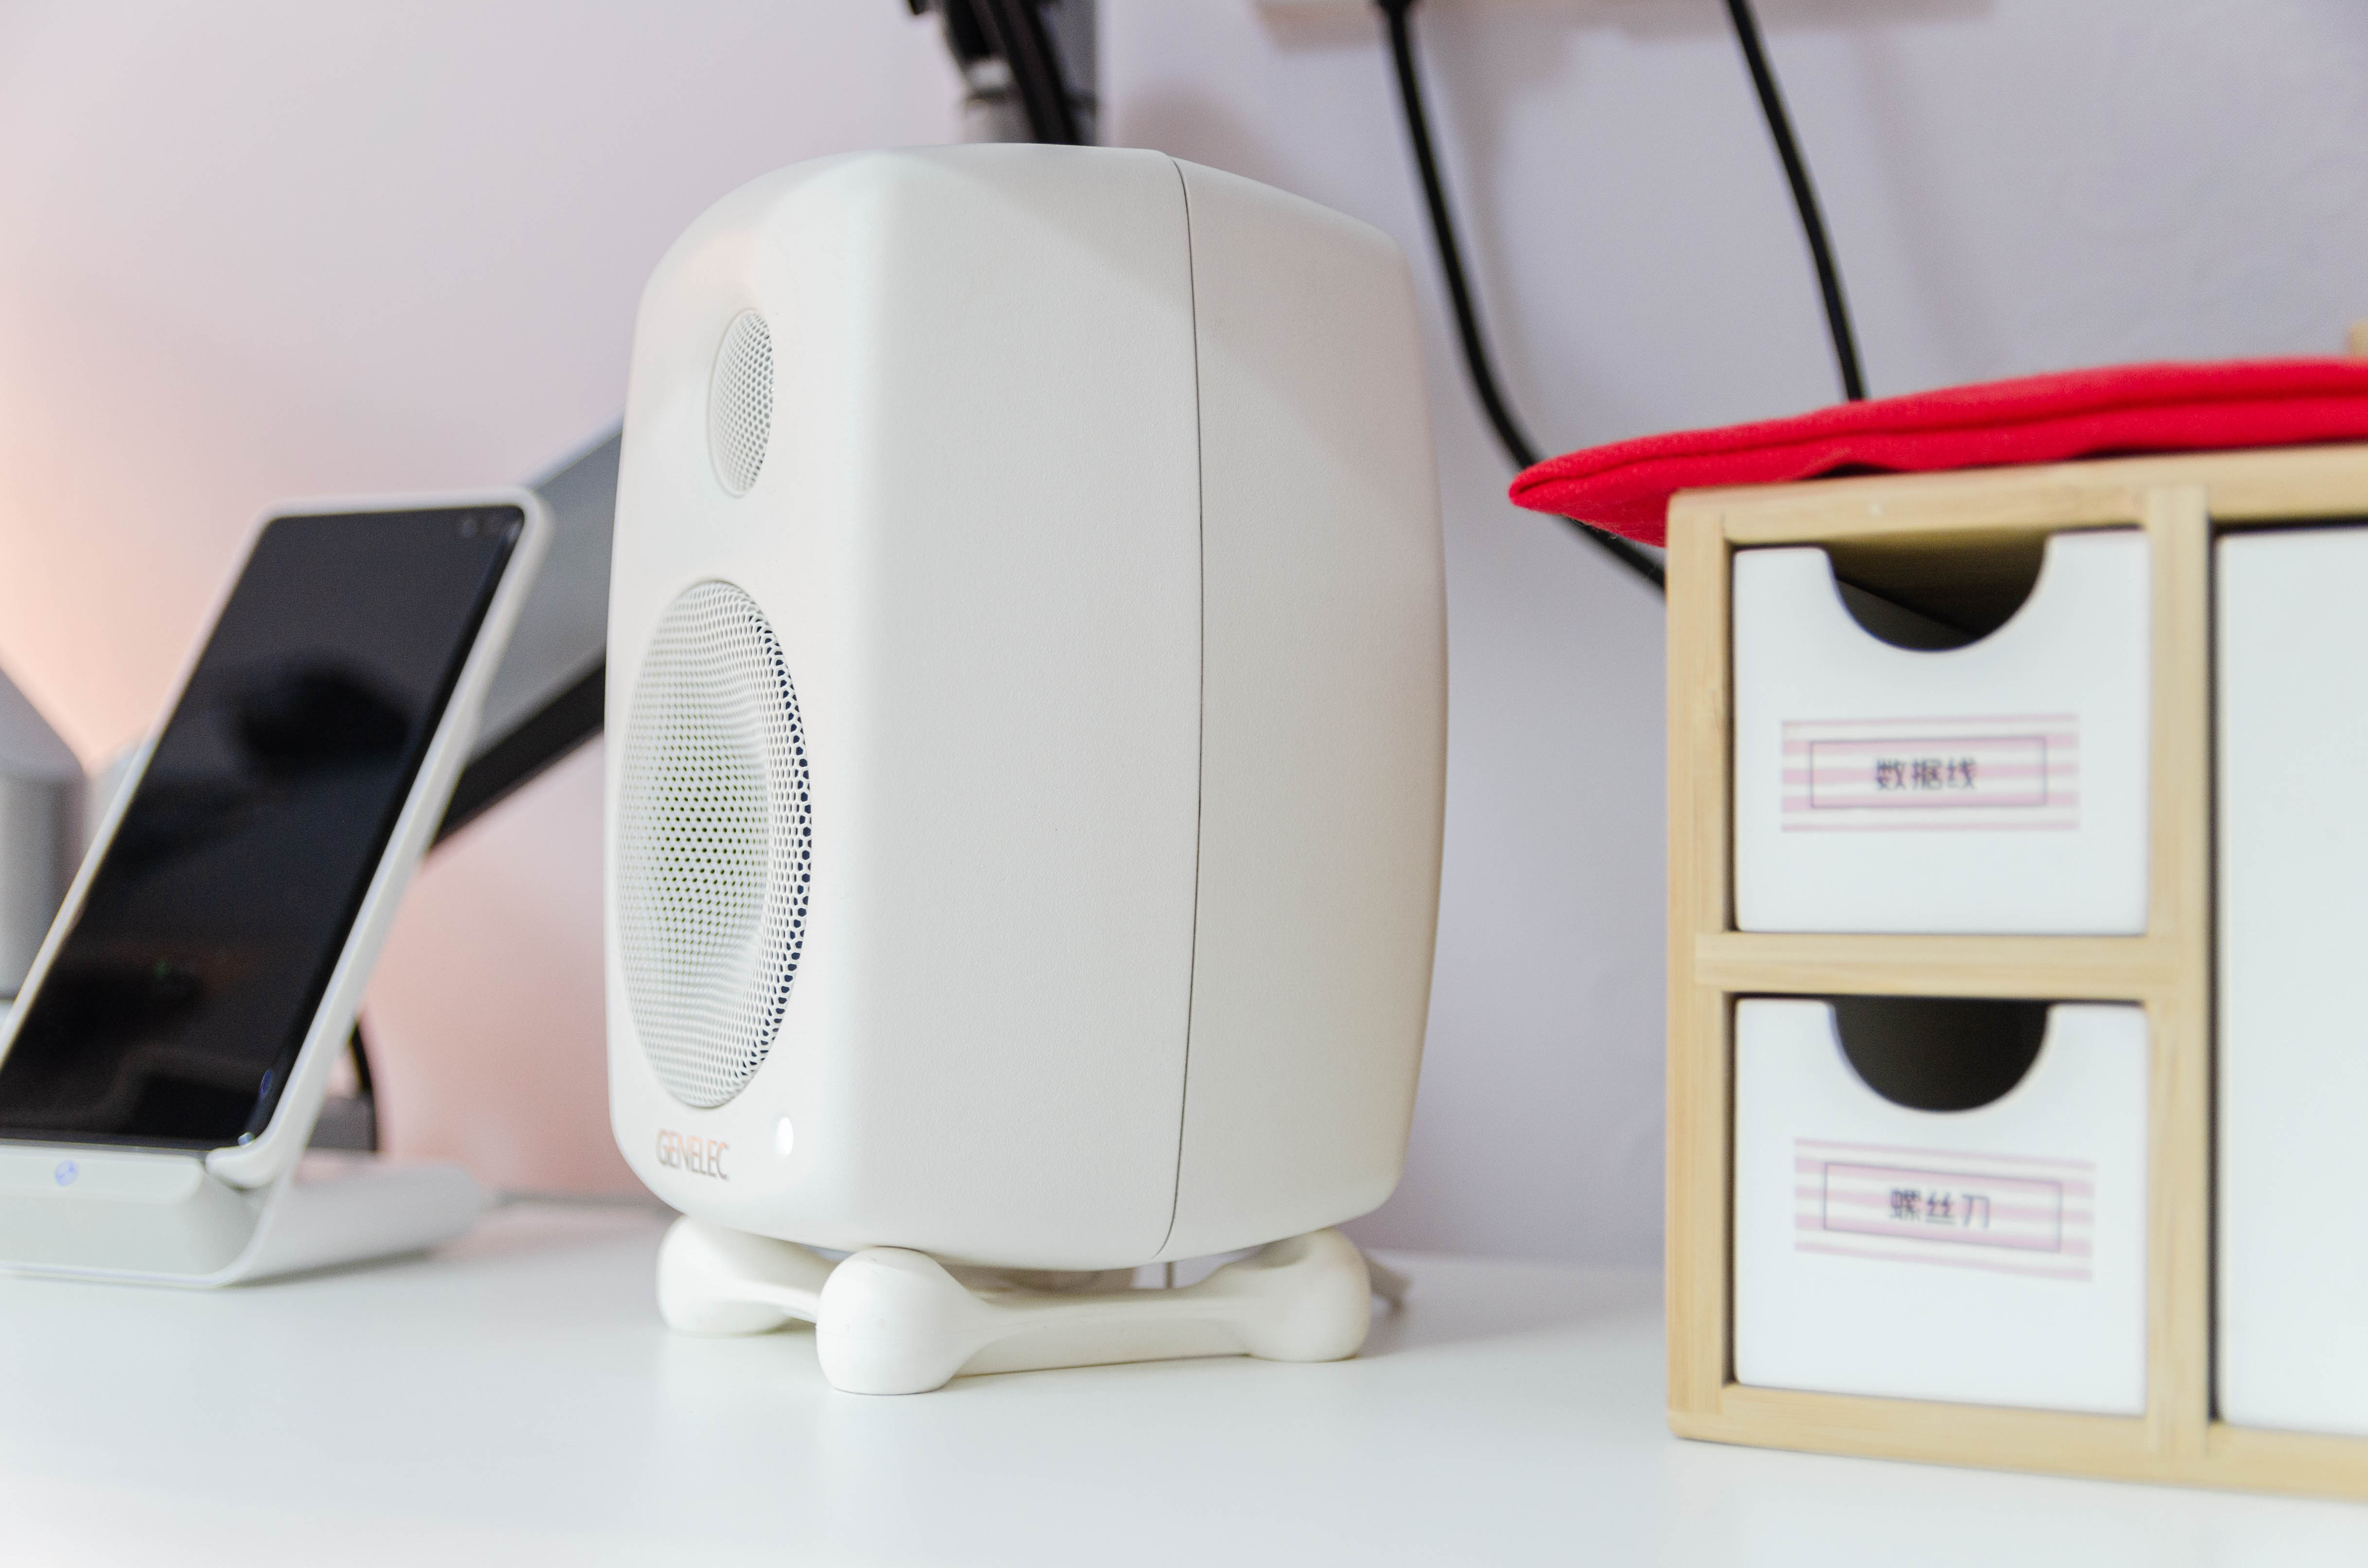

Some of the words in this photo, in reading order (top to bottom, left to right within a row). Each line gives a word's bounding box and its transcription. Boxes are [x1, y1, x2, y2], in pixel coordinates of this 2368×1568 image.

[1875, 757, 1976, 790] 数据线
[656, 1128, 729, 1180] GENELEC
[1889, 1188, 1990, 1228] 螺丝刀
